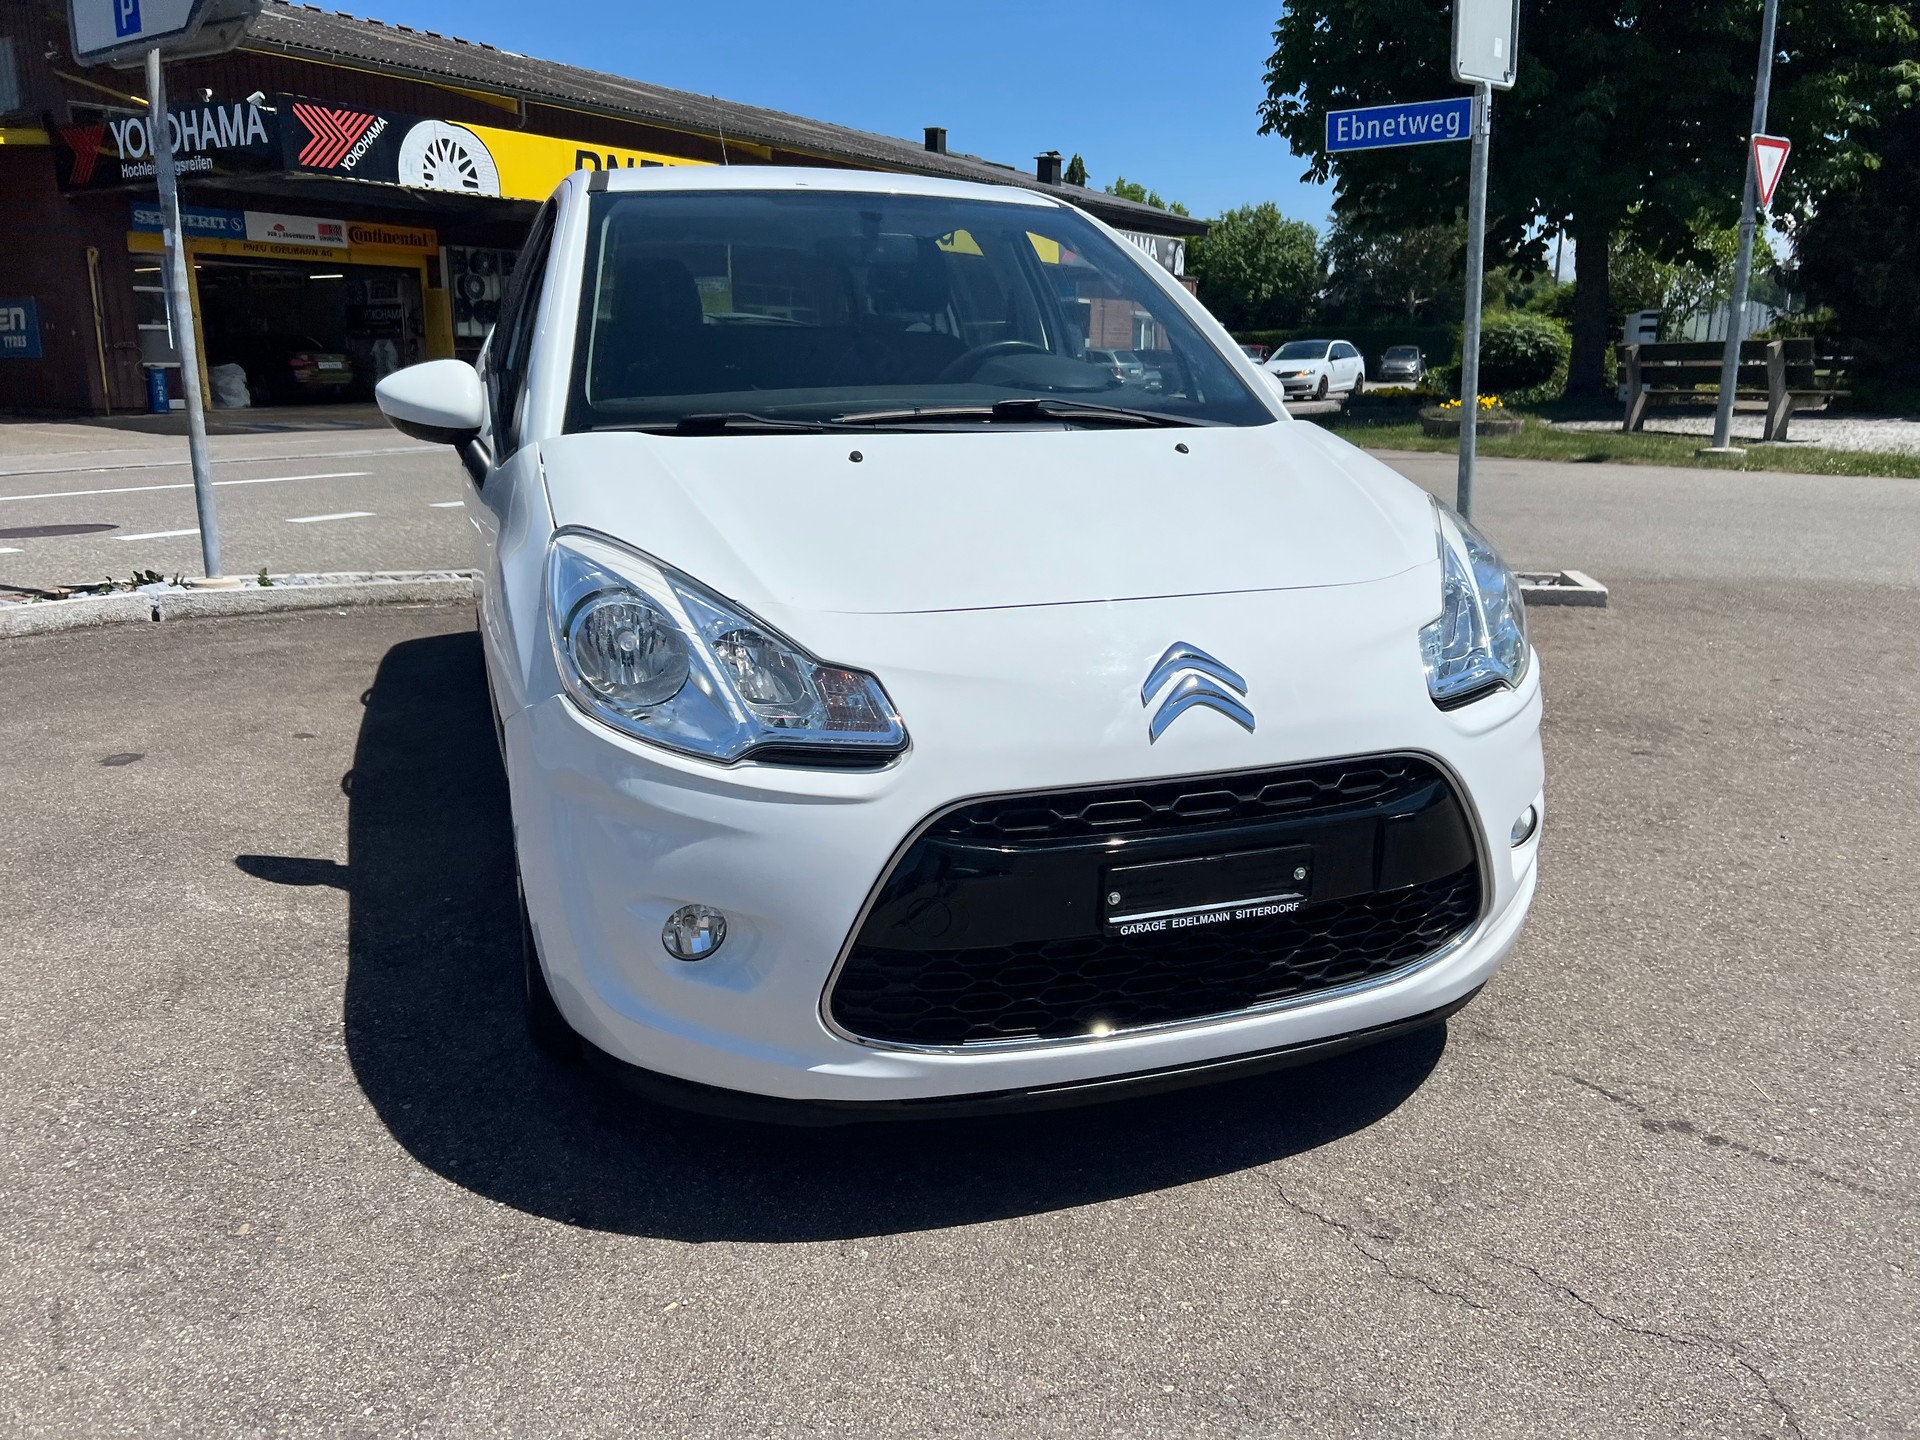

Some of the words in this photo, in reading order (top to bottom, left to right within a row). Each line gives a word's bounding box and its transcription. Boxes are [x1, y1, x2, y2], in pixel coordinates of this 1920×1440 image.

[1337, 111, 1460, 141] Ebnetweg
[340, 116, 389, 171] YOKOHAMA
[348, 226, 428, 247] Continental
[1120, 921, 1167, 935] GARAGE
[1172, 911, 1231, 928] EDELMANN
[1235, 902, 1300, 919] SITTERDORF
